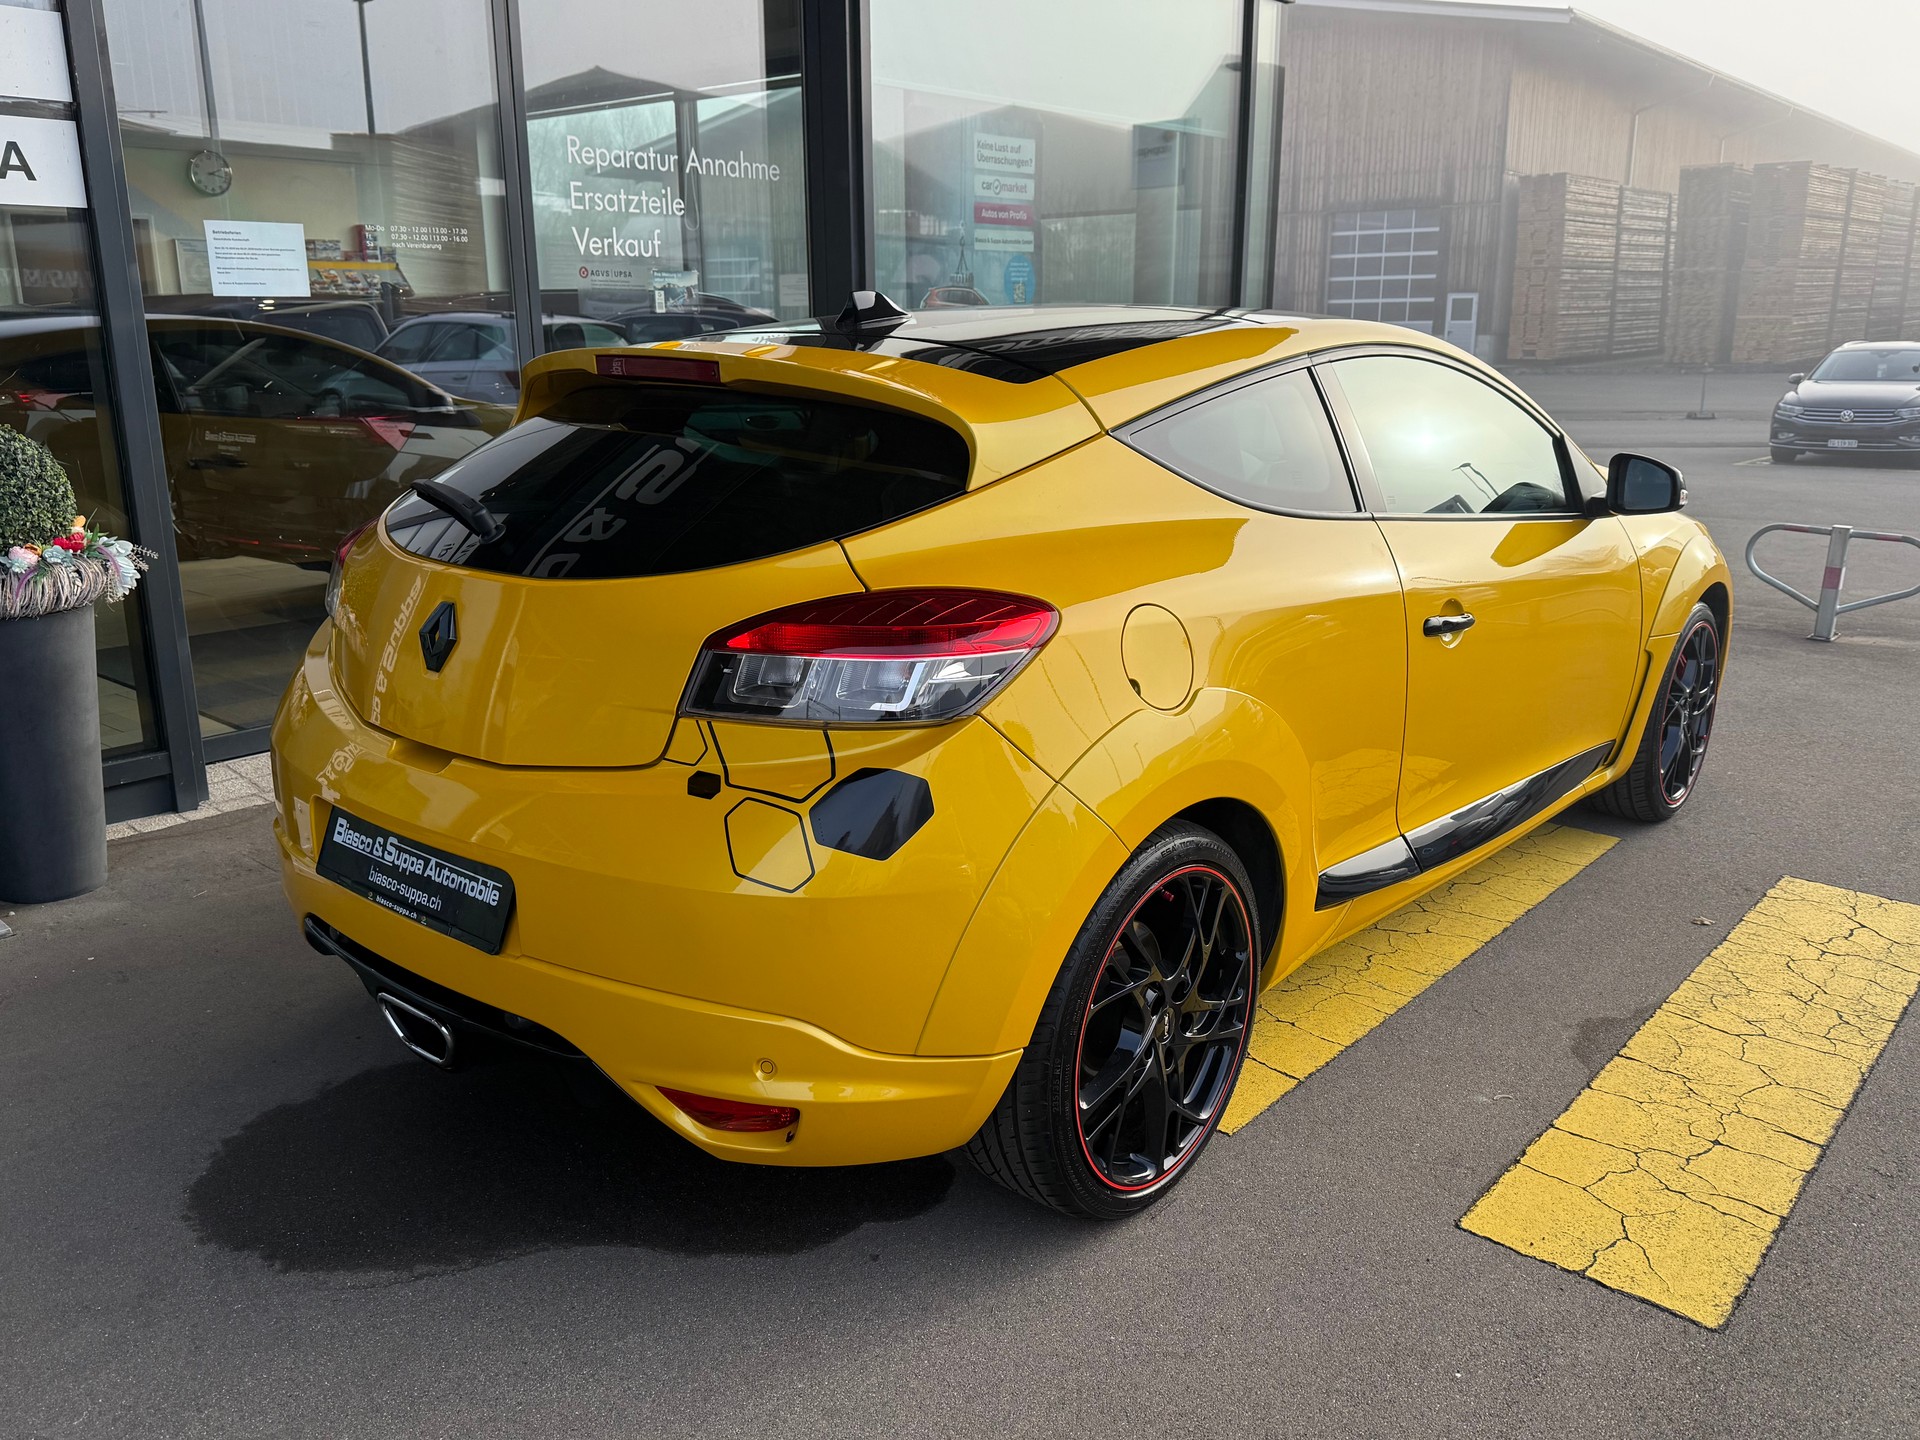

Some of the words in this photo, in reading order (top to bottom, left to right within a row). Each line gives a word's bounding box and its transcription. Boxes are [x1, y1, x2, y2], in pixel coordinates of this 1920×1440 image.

[976, 138, 993, 151] Keine
[994, 142, 1009, 153] Lust
[1009, 144, 1022, 154] auf
[566, 135, 678, 173] Reparatur
[686, 147, 780, 181] Annahme
[976, 150, 1033, 168] Überraschungen?
[569, 181, 685, 216] Ersatzteile
[981, 208, 998, 218] Autos
[998, 211, 1009, 219] von
[1009, 210, 1028, 220] Profis
[364, 224, 385, 232] Mo-Do
[390, 225, 407, 233] 07.30
[406, 242, 442, 250] Vereinbarung
[571, 226, 662, 258] Verkauf
[614, 270, 633, 278] UPSA
[333, 816, 373, 852] Biasco
[373, 836, 385, 858] &
[384, 836, 425, 875] Suppa
[423, 858, 500, 906] Automobile
[368, 865, 442, 911] biasco-suppa.ch
[375, 895, 418, 919] biasco-suppa.ch
